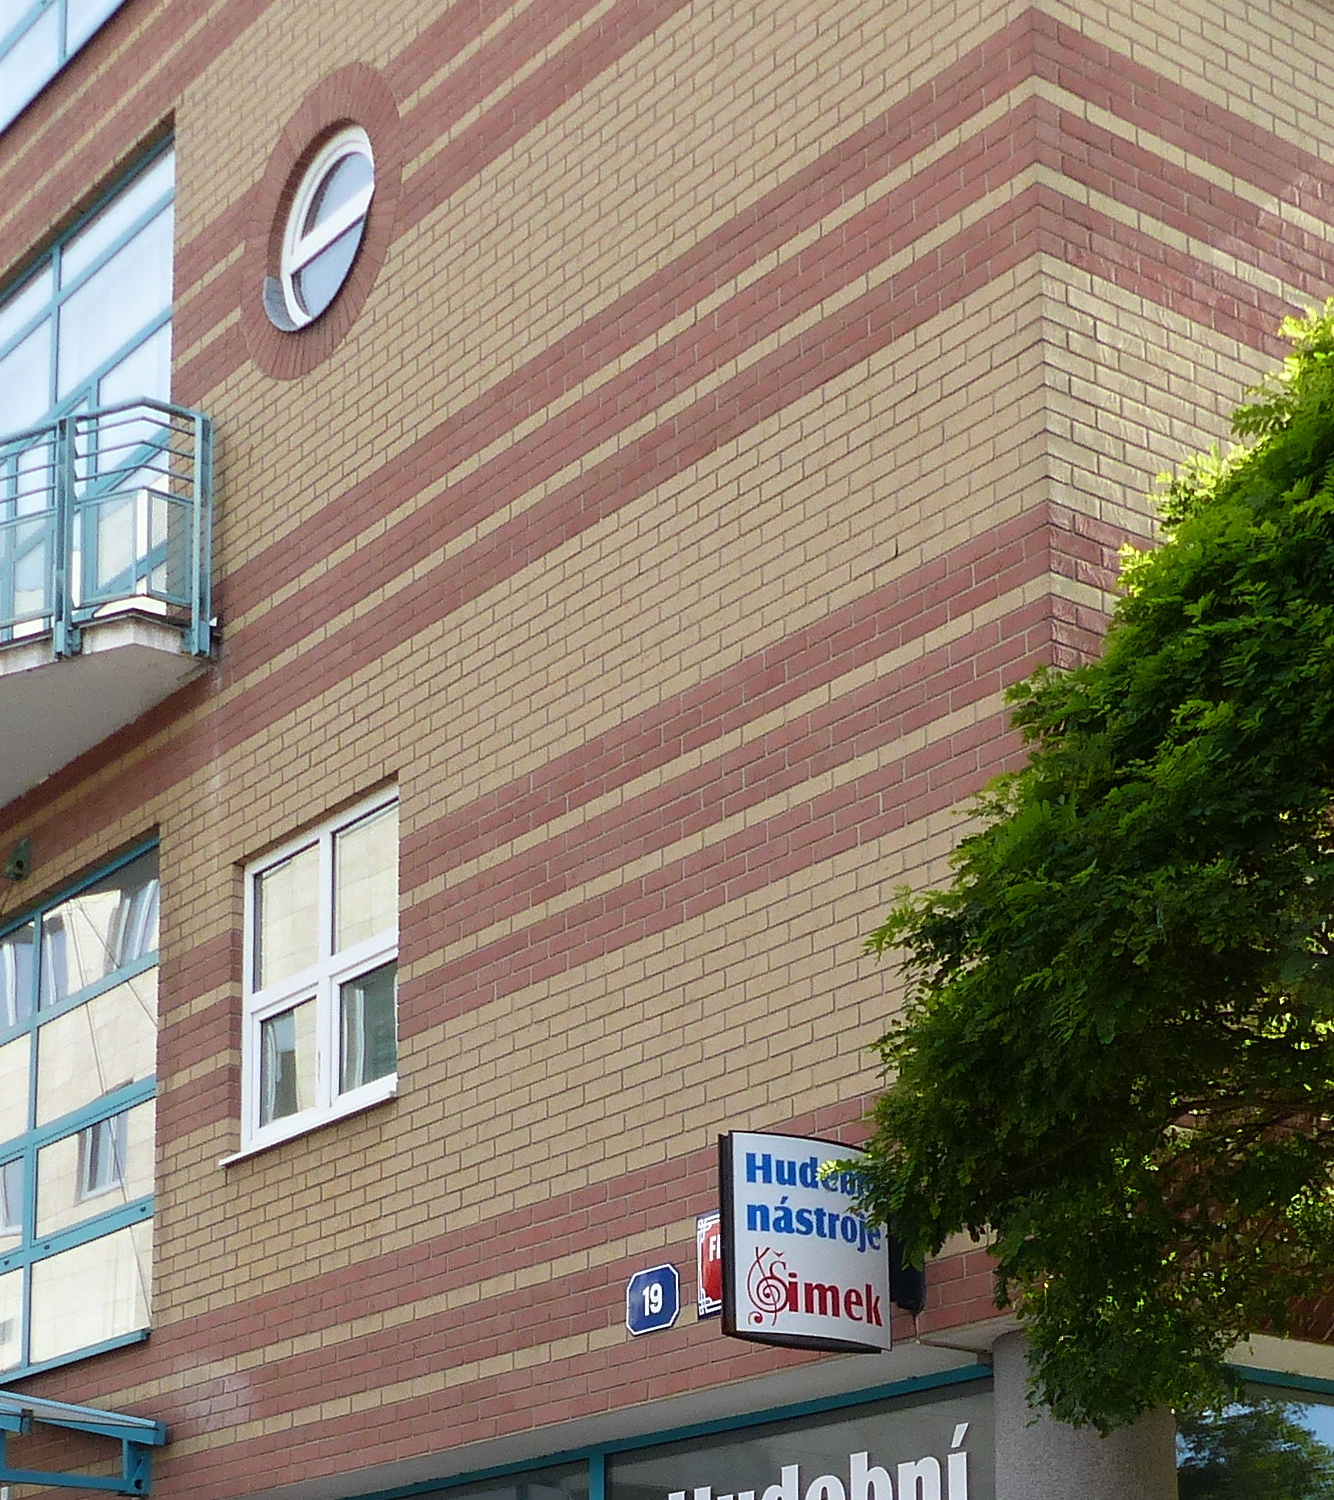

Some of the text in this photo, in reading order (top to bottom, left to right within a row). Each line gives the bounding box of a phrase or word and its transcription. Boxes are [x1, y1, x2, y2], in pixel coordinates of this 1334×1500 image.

[746, 1196, 881, 1253] nástroje
[642, 1283, 663, 1316] 19
[747, 1246, 883, 1327] Šimek
